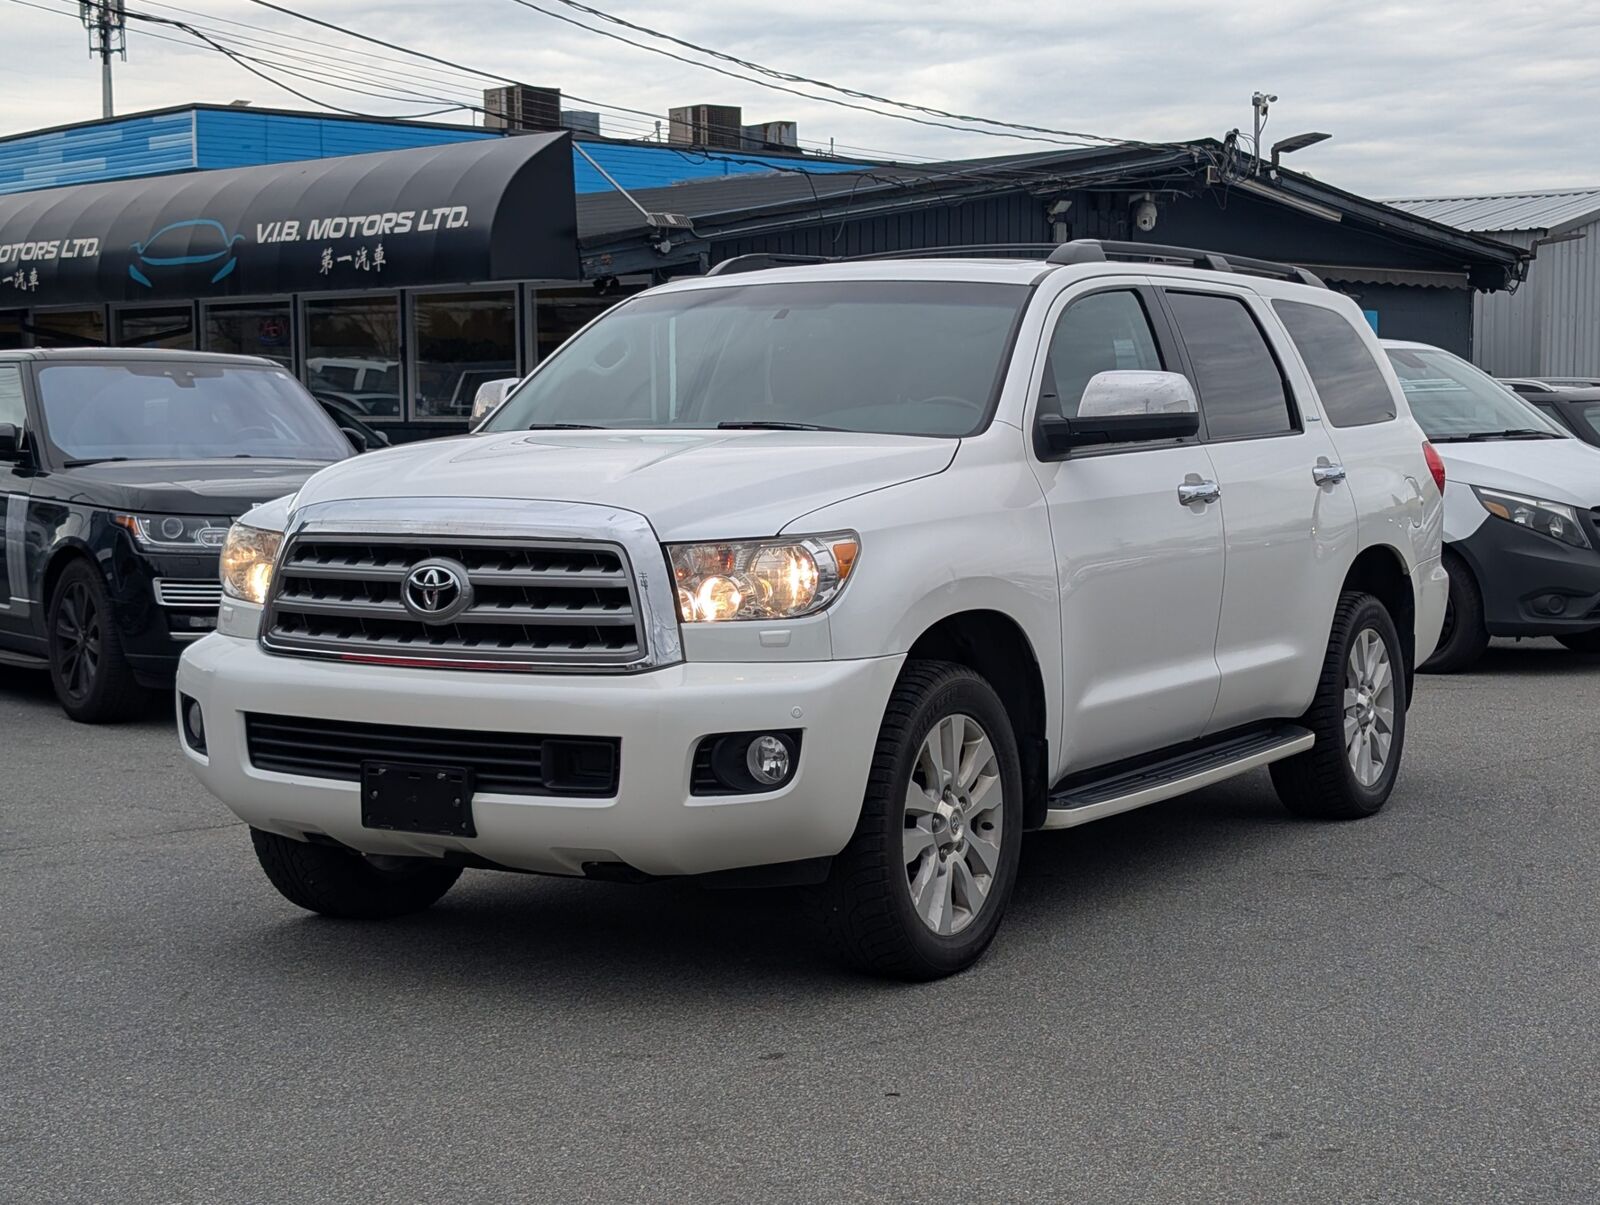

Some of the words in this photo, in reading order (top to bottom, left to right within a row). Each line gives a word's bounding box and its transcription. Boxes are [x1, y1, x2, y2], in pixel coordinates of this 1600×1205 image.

[257, 221, 300, 243] V.I.B.
[306, 211, 415, 240] MOTORS
[417, 205, 469, 231] LTD.
[0, 240, 60, 263] OTORS
[60, 238, 99, 258] LTD.
[320, 244, 387, 275] 第一汽車
[0, 266, 39, 292] 一汽車
